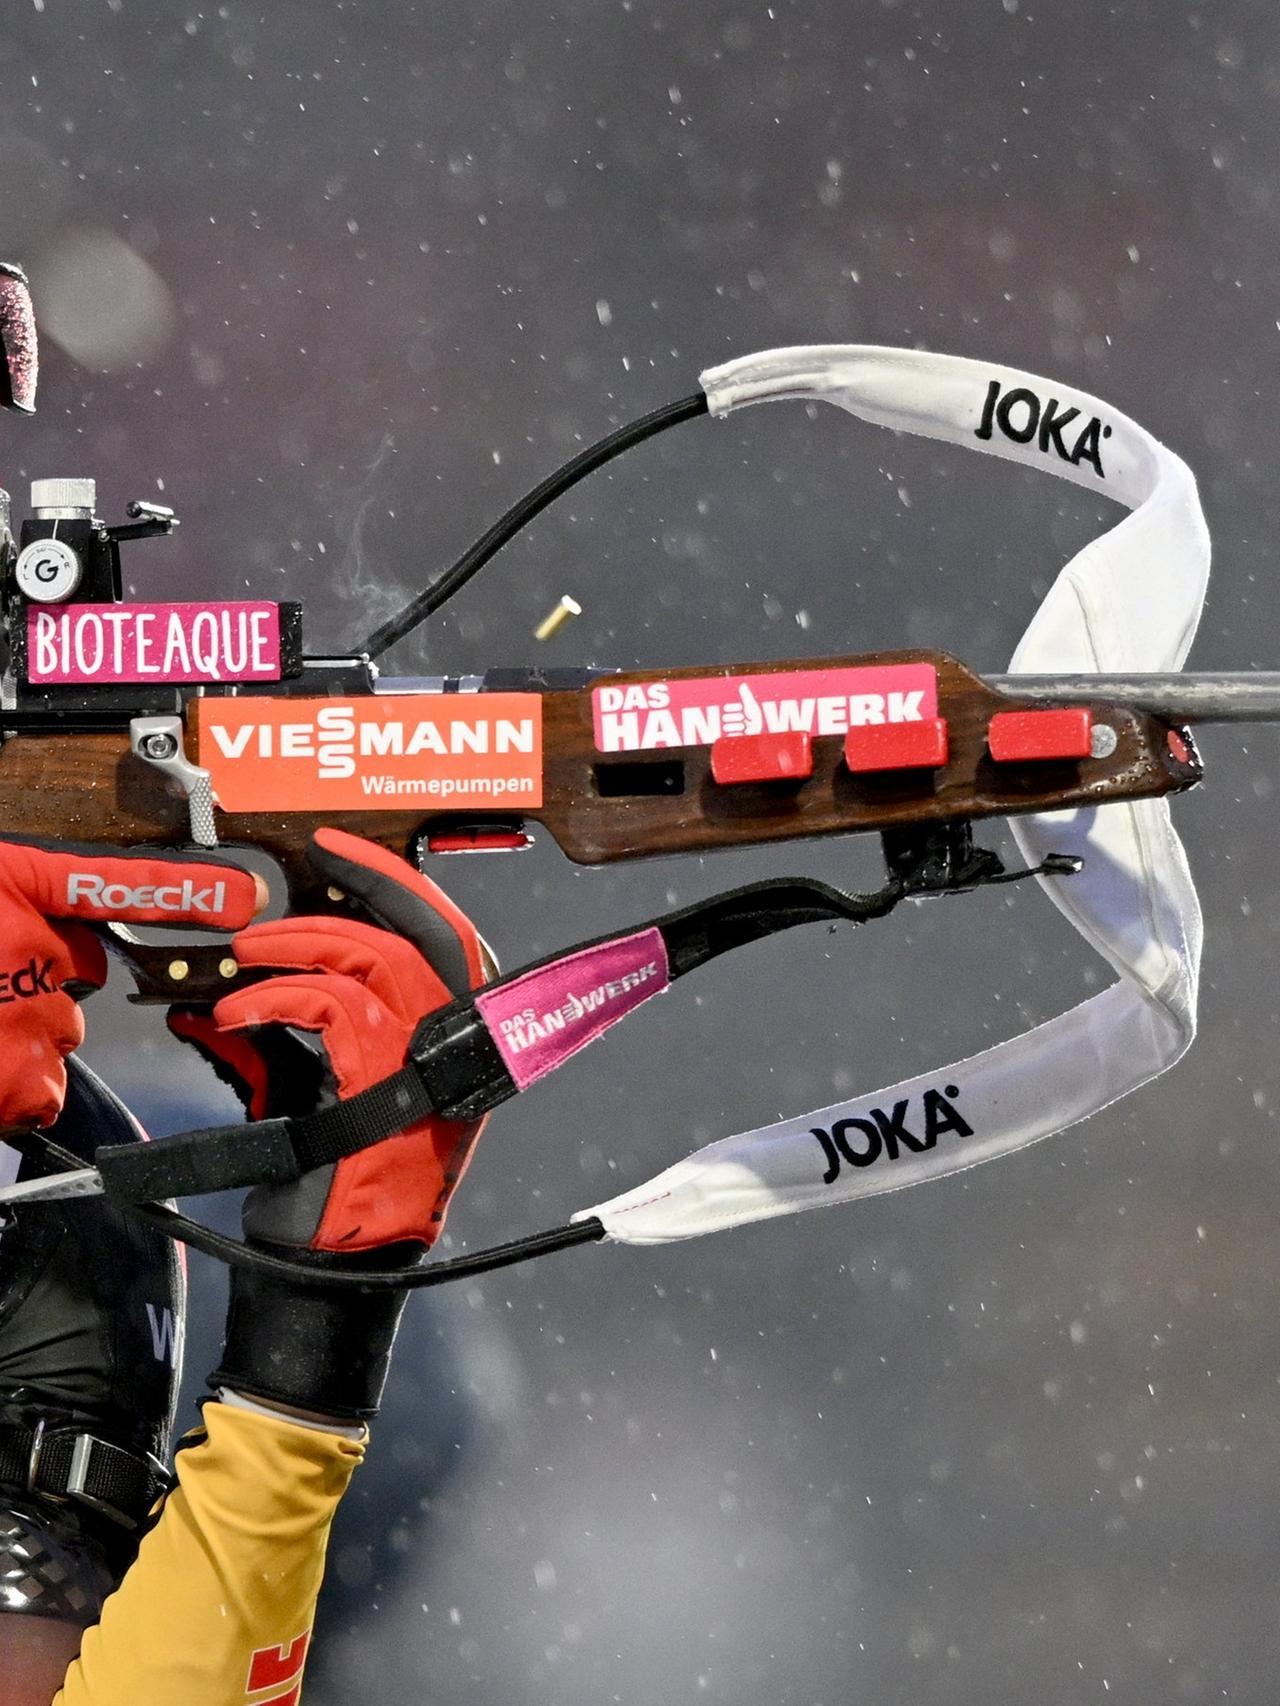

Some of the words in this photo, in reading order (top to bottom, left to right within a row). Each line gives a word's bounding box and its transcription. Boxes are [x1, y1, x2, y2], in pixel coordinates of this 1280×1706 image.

[974, 380, 1106, 479] JOKA
[36, 610, 276, 680] BIOTEAQUE
[600, 683, 671, 712] DAS
[210, 706, 534, 779] VIESSMANN
[361, 774, 534, 797] Wärmepumpen
[499, 1008, 537, 1035] DAS
[808, 1088, 974, 1184] JOKA
